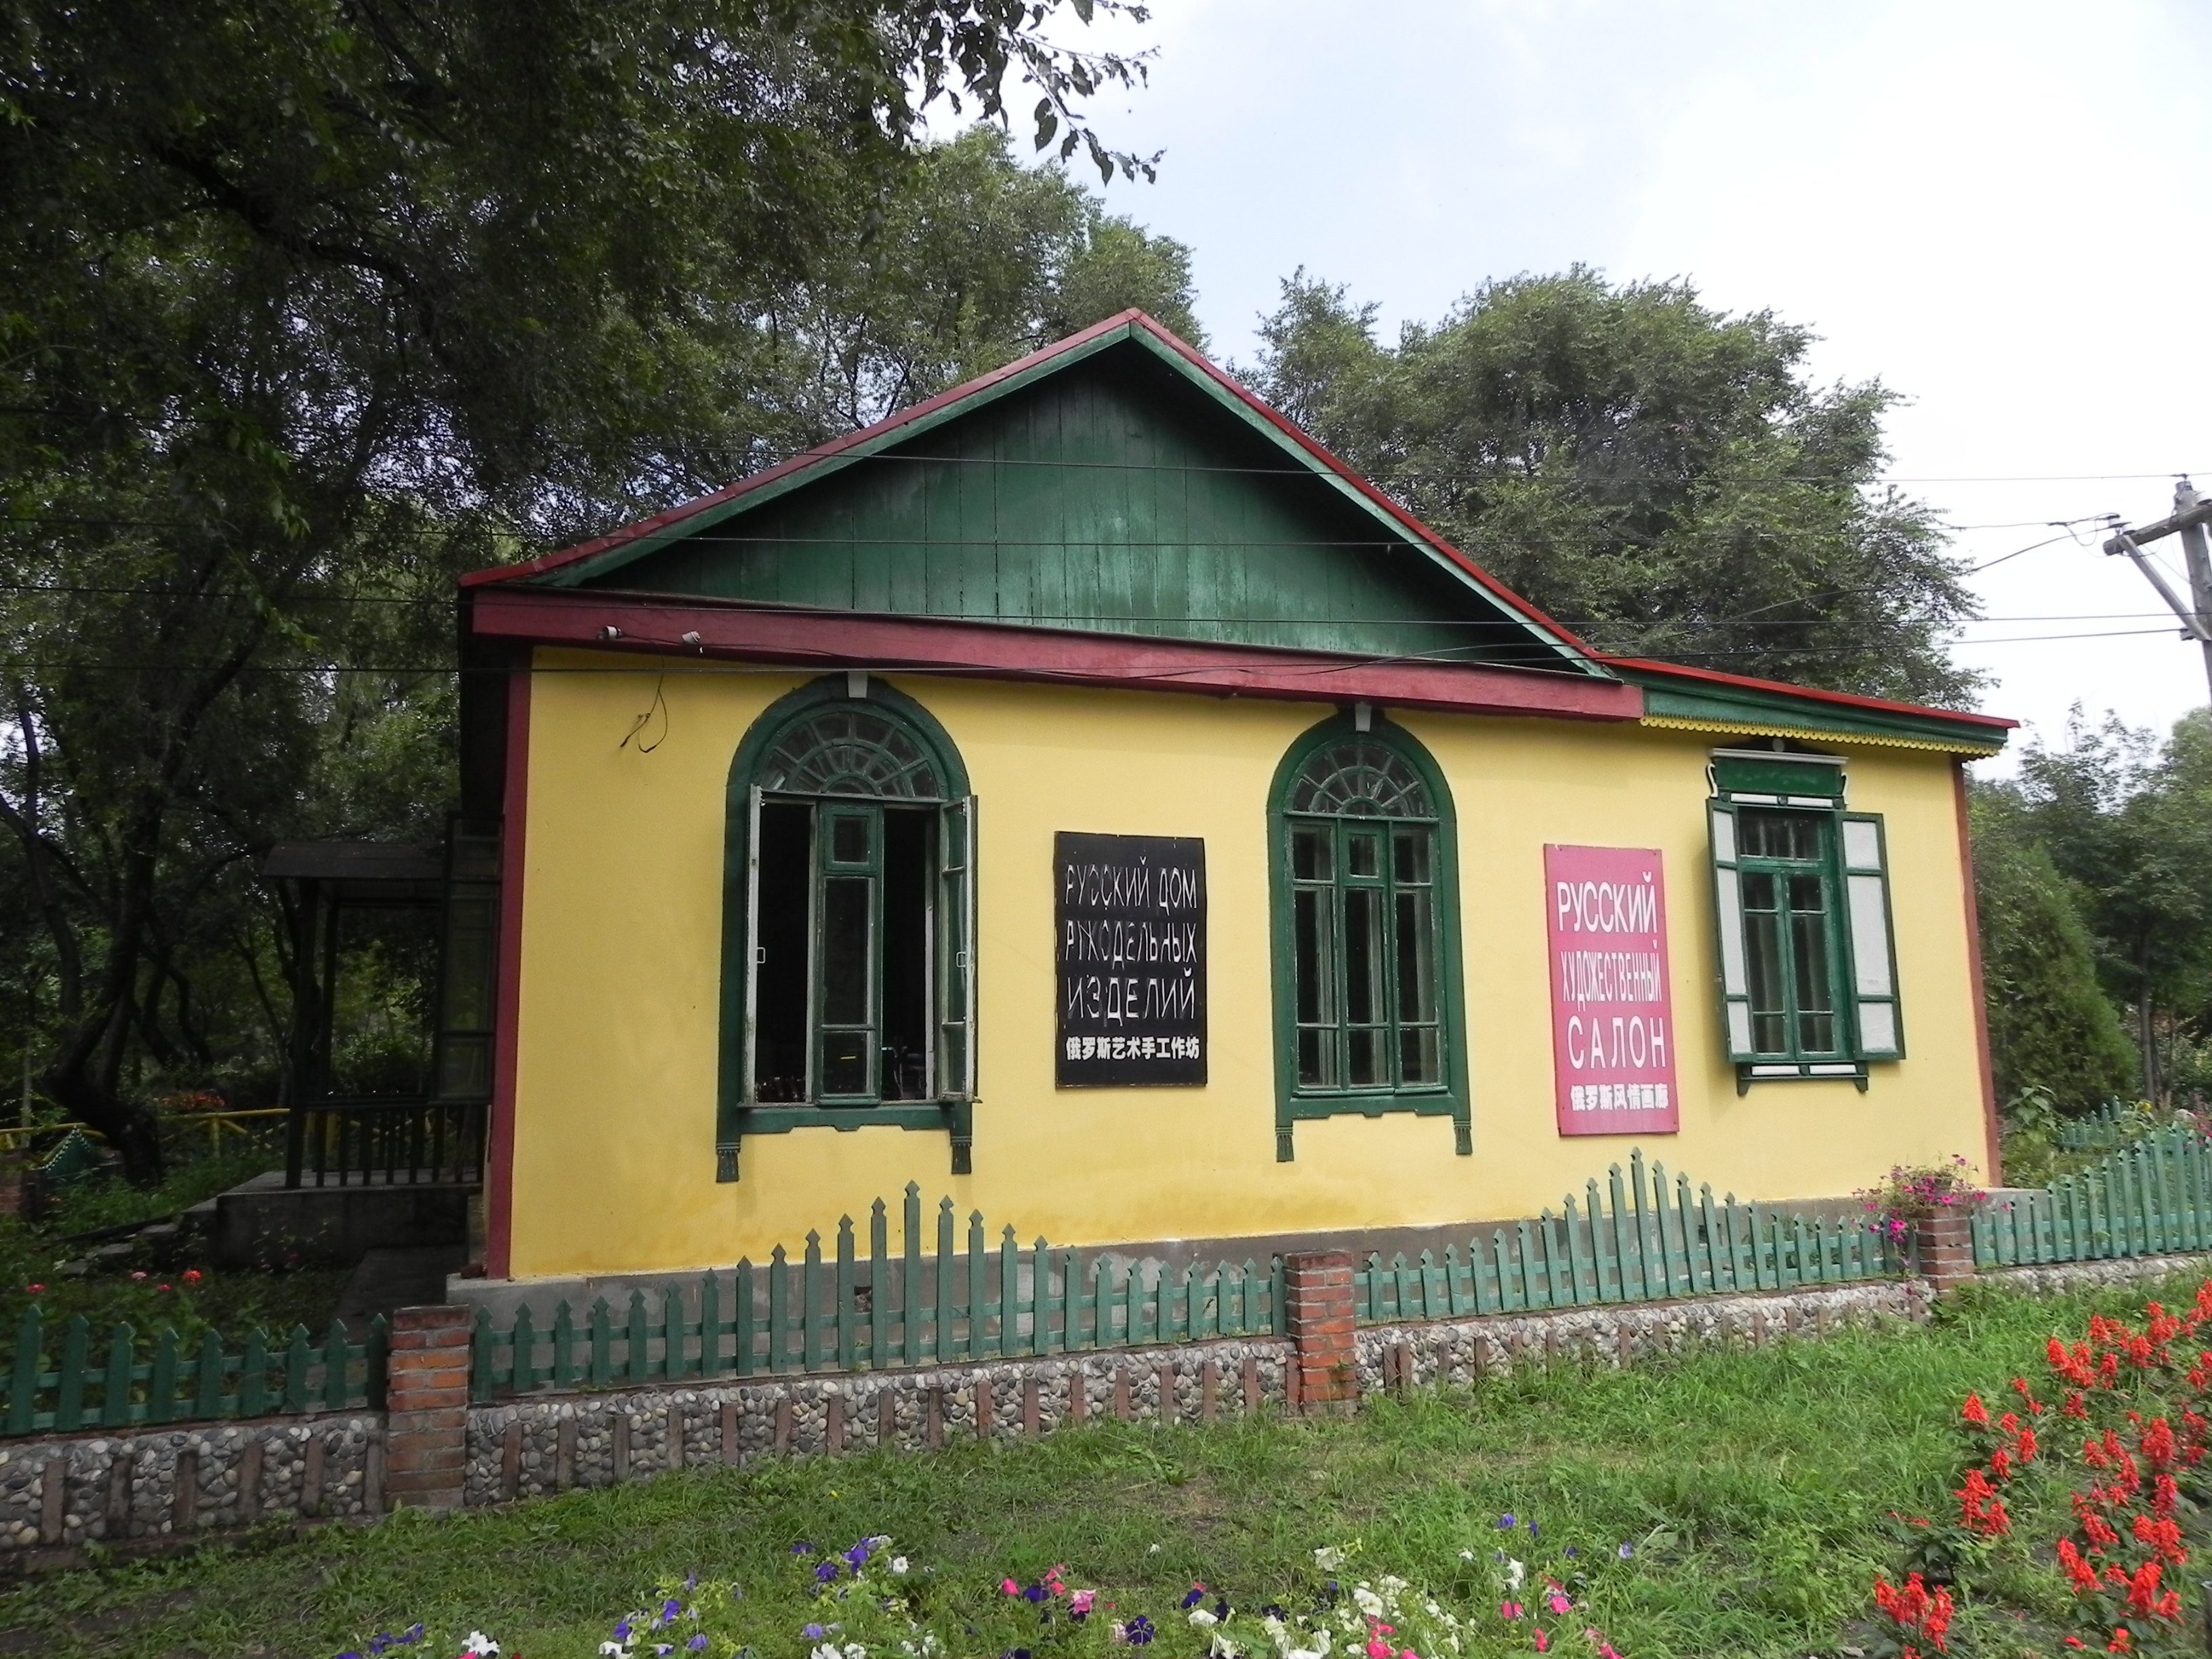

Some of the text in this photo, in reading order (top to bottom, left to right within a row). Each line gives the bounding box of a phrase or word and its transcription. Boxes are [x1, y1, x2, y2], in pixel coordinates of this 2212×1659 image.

[1159, 867, 1197, 916] ДОМ
[1557, 872, 1657, 933] РУССКИЙ
[1067, 967, 1195, 1027] ИЗДЕЛИЙ
[1561, 939, 1662, 1011] ХУДОЖЕСТВЕННЫЙ
[1066, 1036, 1200, 1061] 俄罗斯艺术手工作坊
[1568, 1015, 1666, 1069] САЛОН
[1570, 1083, 1668, 1111] 俄罗斯风情画廊
